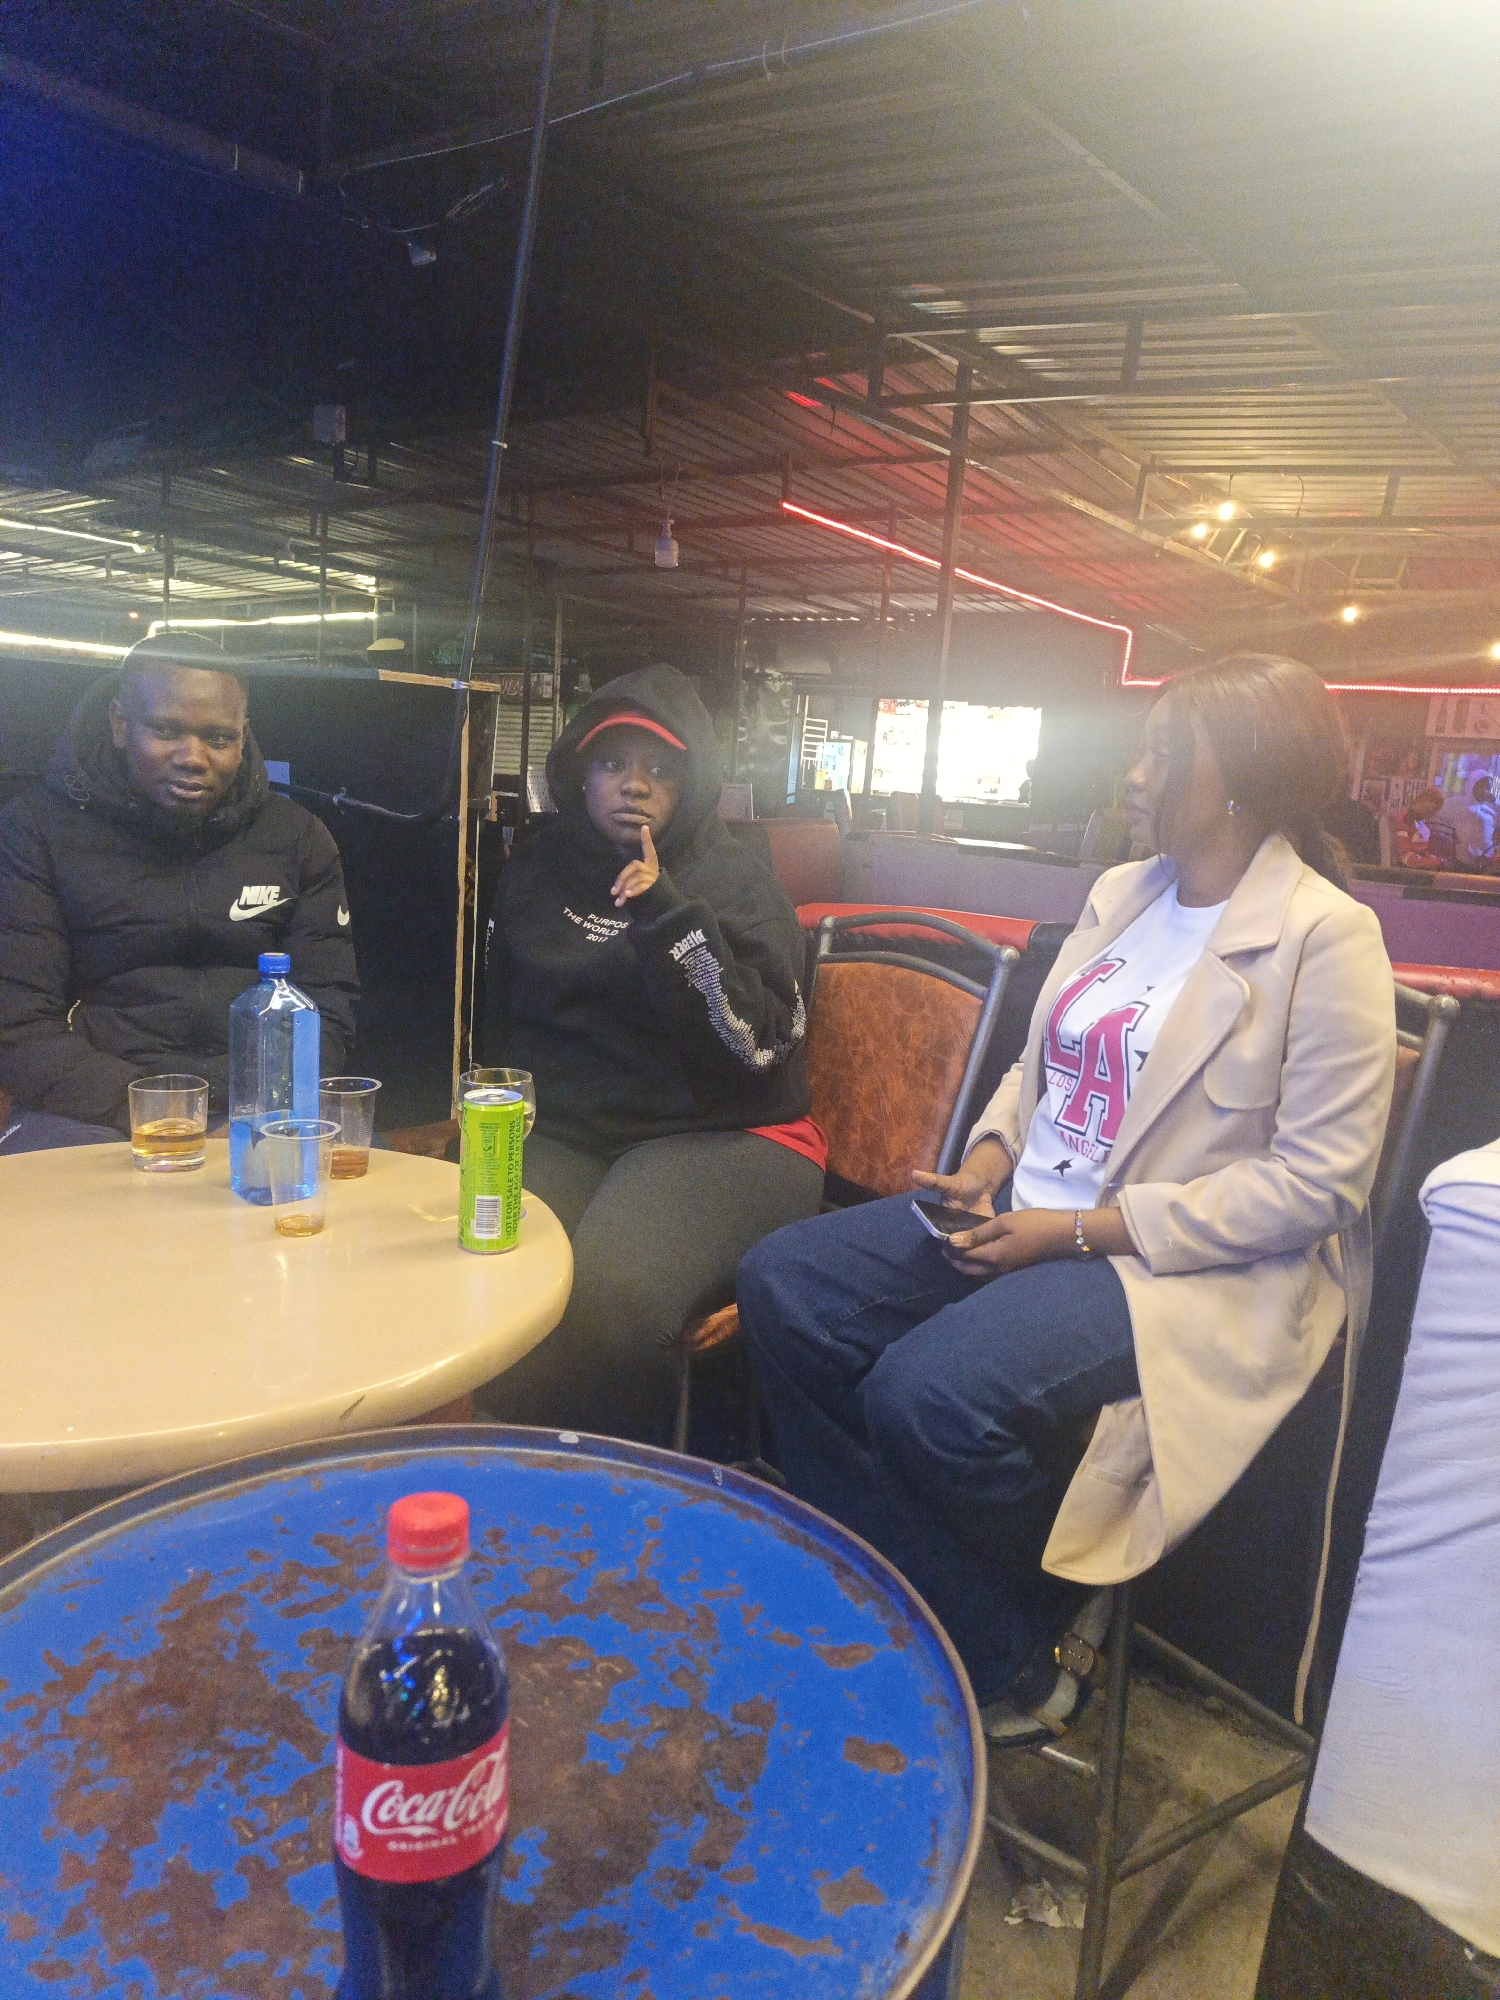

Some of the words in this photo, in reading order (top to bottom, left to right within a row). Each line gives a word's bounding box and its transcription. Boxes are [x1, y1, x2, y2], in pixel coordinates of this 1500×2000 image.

[239, 886, 280, 905] NIKE
[563, 906, 584, 925] THE
[582, 920, 619, 936] WORLD
[587, 913, 629, 929] PURPOS
[585, 933, 609, 943] 2017
[668, 928, 708, 962] BIEBER
[1048, 1071, 1074, 1093] LOS
[508, 1120, 516, 1161] PERSONS
[508, 1163, 514, 1176] TO
